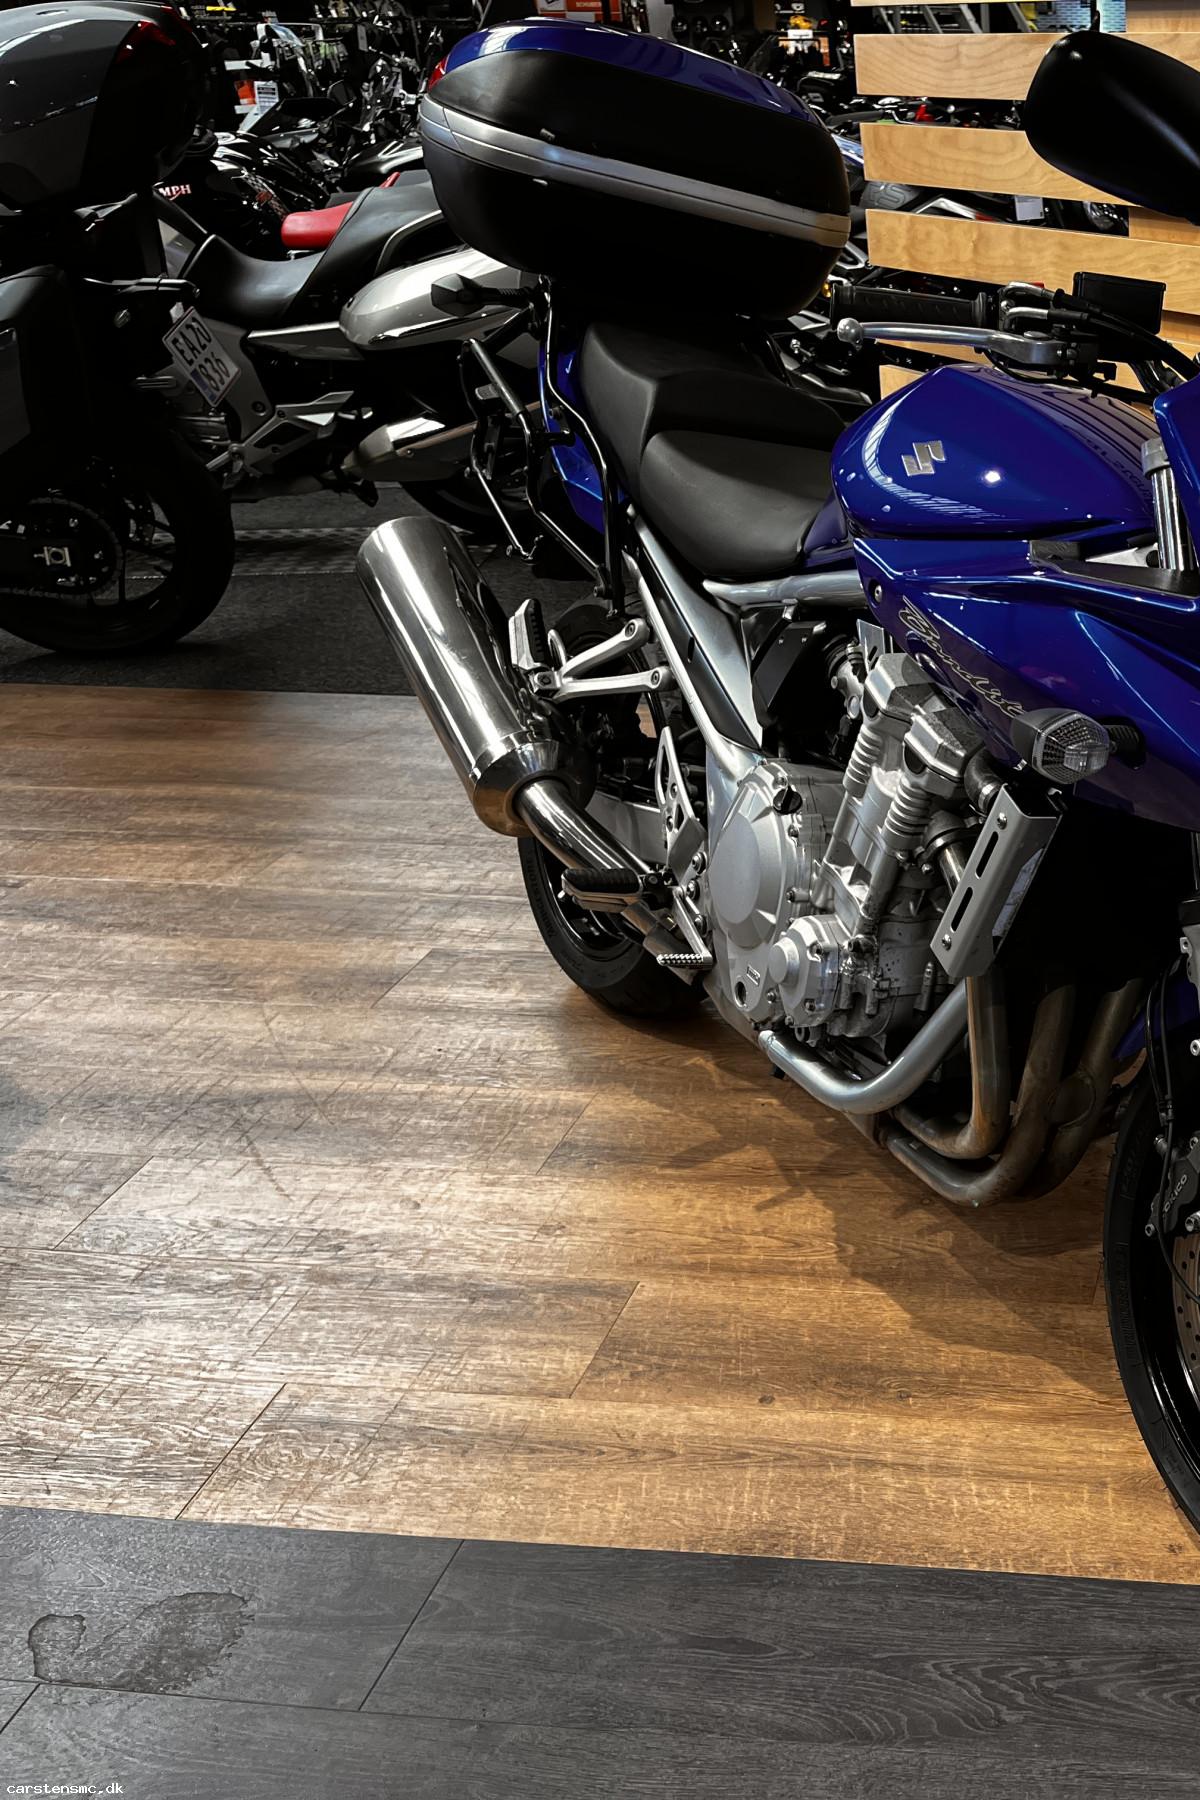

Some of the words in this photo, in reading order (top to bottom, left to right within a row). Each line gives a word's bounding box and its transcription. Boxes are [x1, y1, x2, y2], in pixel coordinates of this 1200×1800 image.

[198, 352, 230, 392] 836
[898, 594, 1026, 719] Bandit
[1161, 1174, 1188, 1214] OKICO
